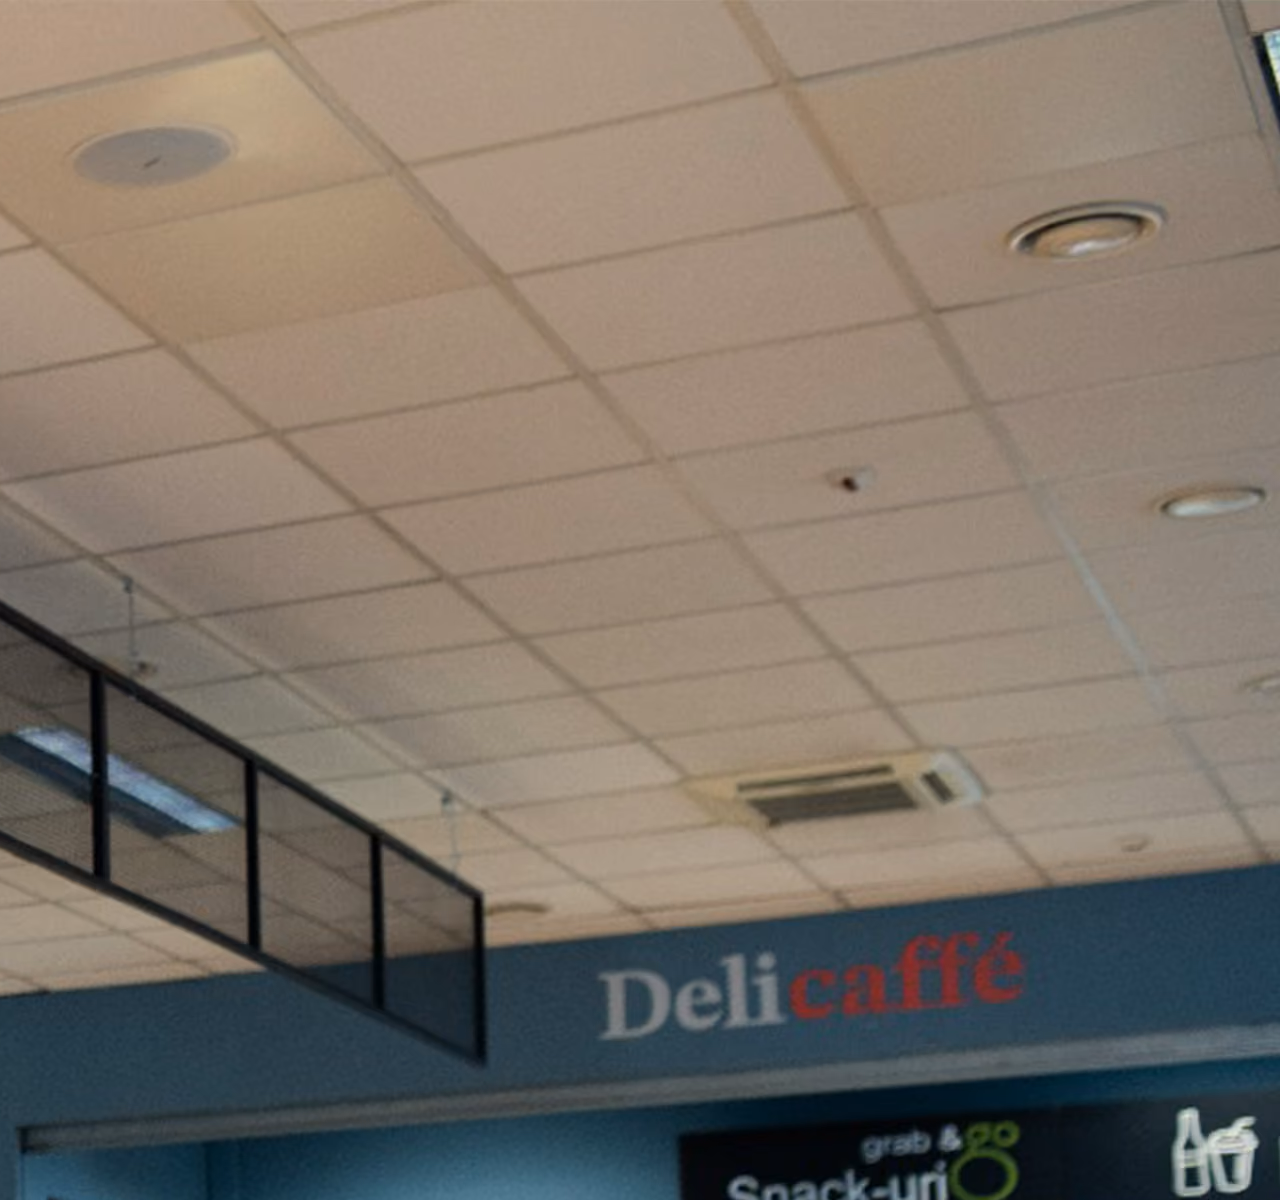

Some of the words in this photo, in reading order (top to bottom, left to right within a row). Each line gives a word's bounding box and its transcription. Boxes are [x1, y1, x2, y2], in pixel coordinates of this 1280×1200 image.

[598, 930, 1028, 1041] Delicaffé
[861, 1129, 931, 1162] grab
[938, 1124, 962, 1152] &
